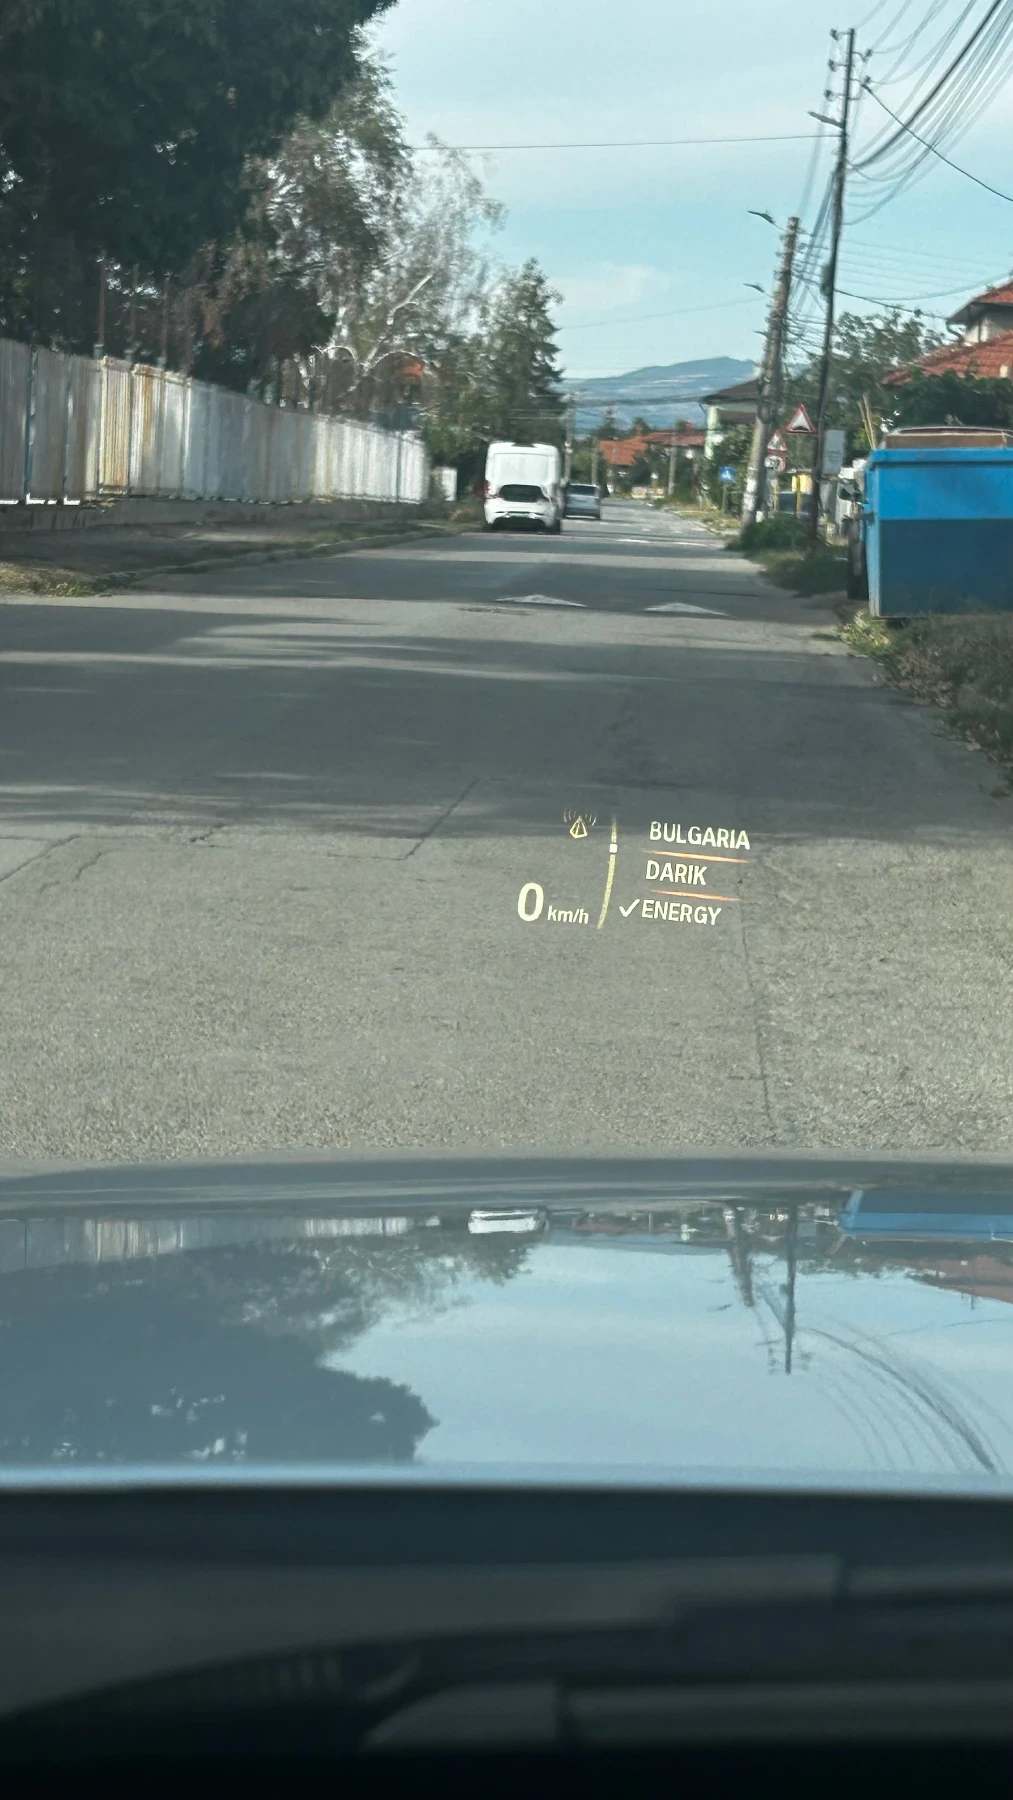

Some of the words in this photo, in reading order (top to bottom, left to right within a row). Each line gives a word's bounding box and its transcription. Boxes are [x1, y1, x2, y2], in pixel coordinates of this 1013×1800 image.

[649, 821, 750, 850] BULGARIA
[645, 860, 708, 885] DARIK
[517, 882, 544, 922] 0
[547, 905, 589, 925] km/h
[641, 899, 722, 925] ENERGY
